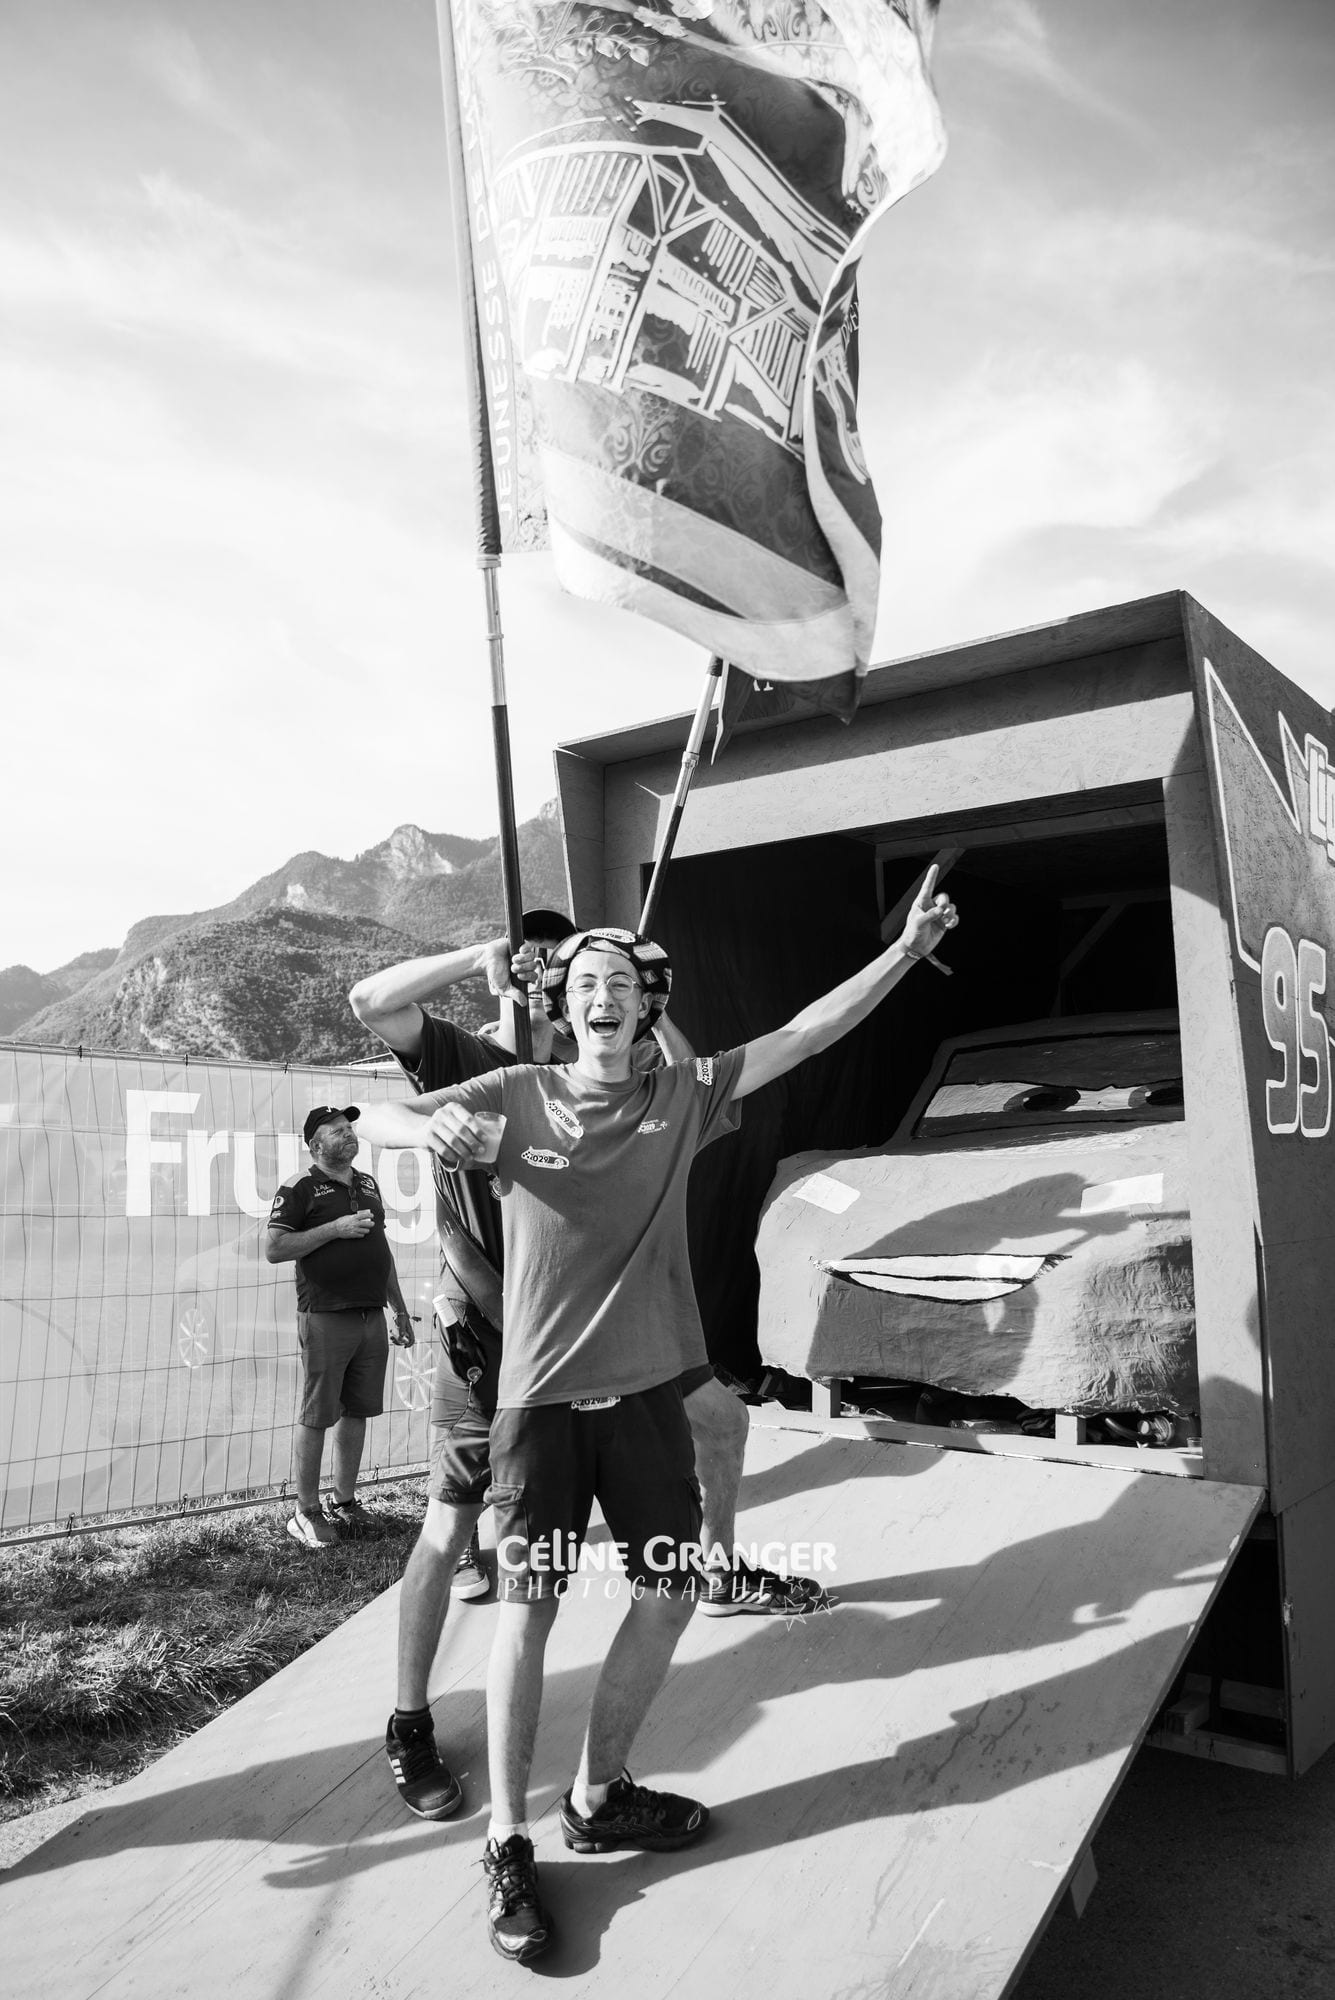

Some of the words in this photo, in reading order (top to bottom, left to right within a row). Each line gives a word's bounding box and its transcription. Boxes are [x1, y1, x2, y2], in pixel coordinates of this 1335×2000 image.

[470, 168, 492, 243] DE
[481, 259, 513, 521] JEUNESSE
[1260, 925, 1331, 1139] 95
[126, 1089, 437, 1245] Frug
[551, 1106, 570, 1124] 2029
